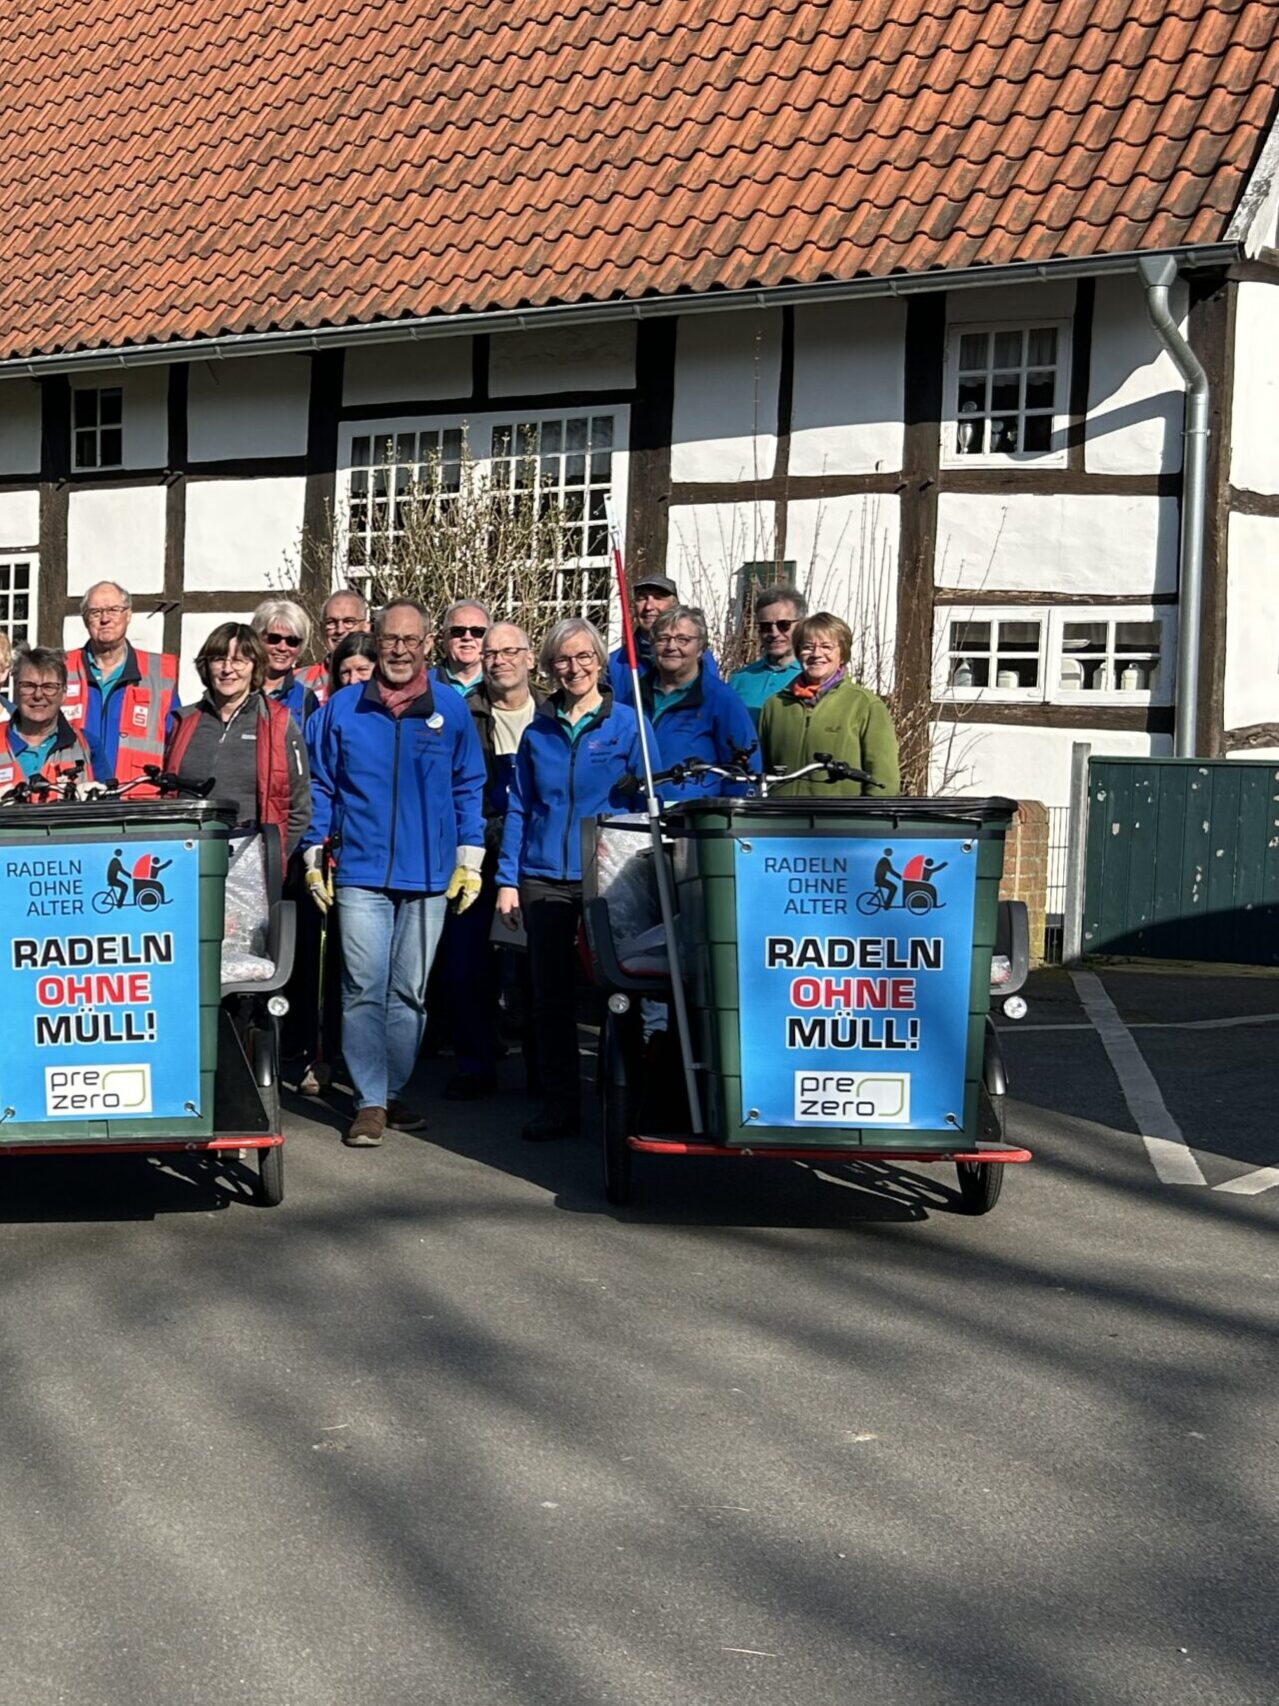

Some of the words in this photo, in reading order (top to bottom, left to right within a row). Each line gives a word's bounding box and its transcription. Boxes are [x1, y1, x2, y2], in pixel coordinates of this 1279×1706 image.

[6, 859, 82, 878] RADELN
[764, 857, 848, 874] RADELN
[29, 879, 84, 896] OHNE
[788, 877, 848, 894] OHNE
[26, 899, 84, 917] ALTER
[783, 898, 848, 915] ALTER
[13, 934, 172, 969] RADELN
[767, 937, 941, 969] RADELN
[37, 974, 150, 1006] OHNE
[792, 978, 915, 1009] OHNE
[36, 1008, 155, 1045] MÜLL!
[788, 1011, 919, 1049] MÜLL!
[50, 1070, 100, 1093] pre
[800, 1075, 855, 1097] pre
[52, 1092, 120, 1111] zero
[800, 1098, 875, 1117] zero
